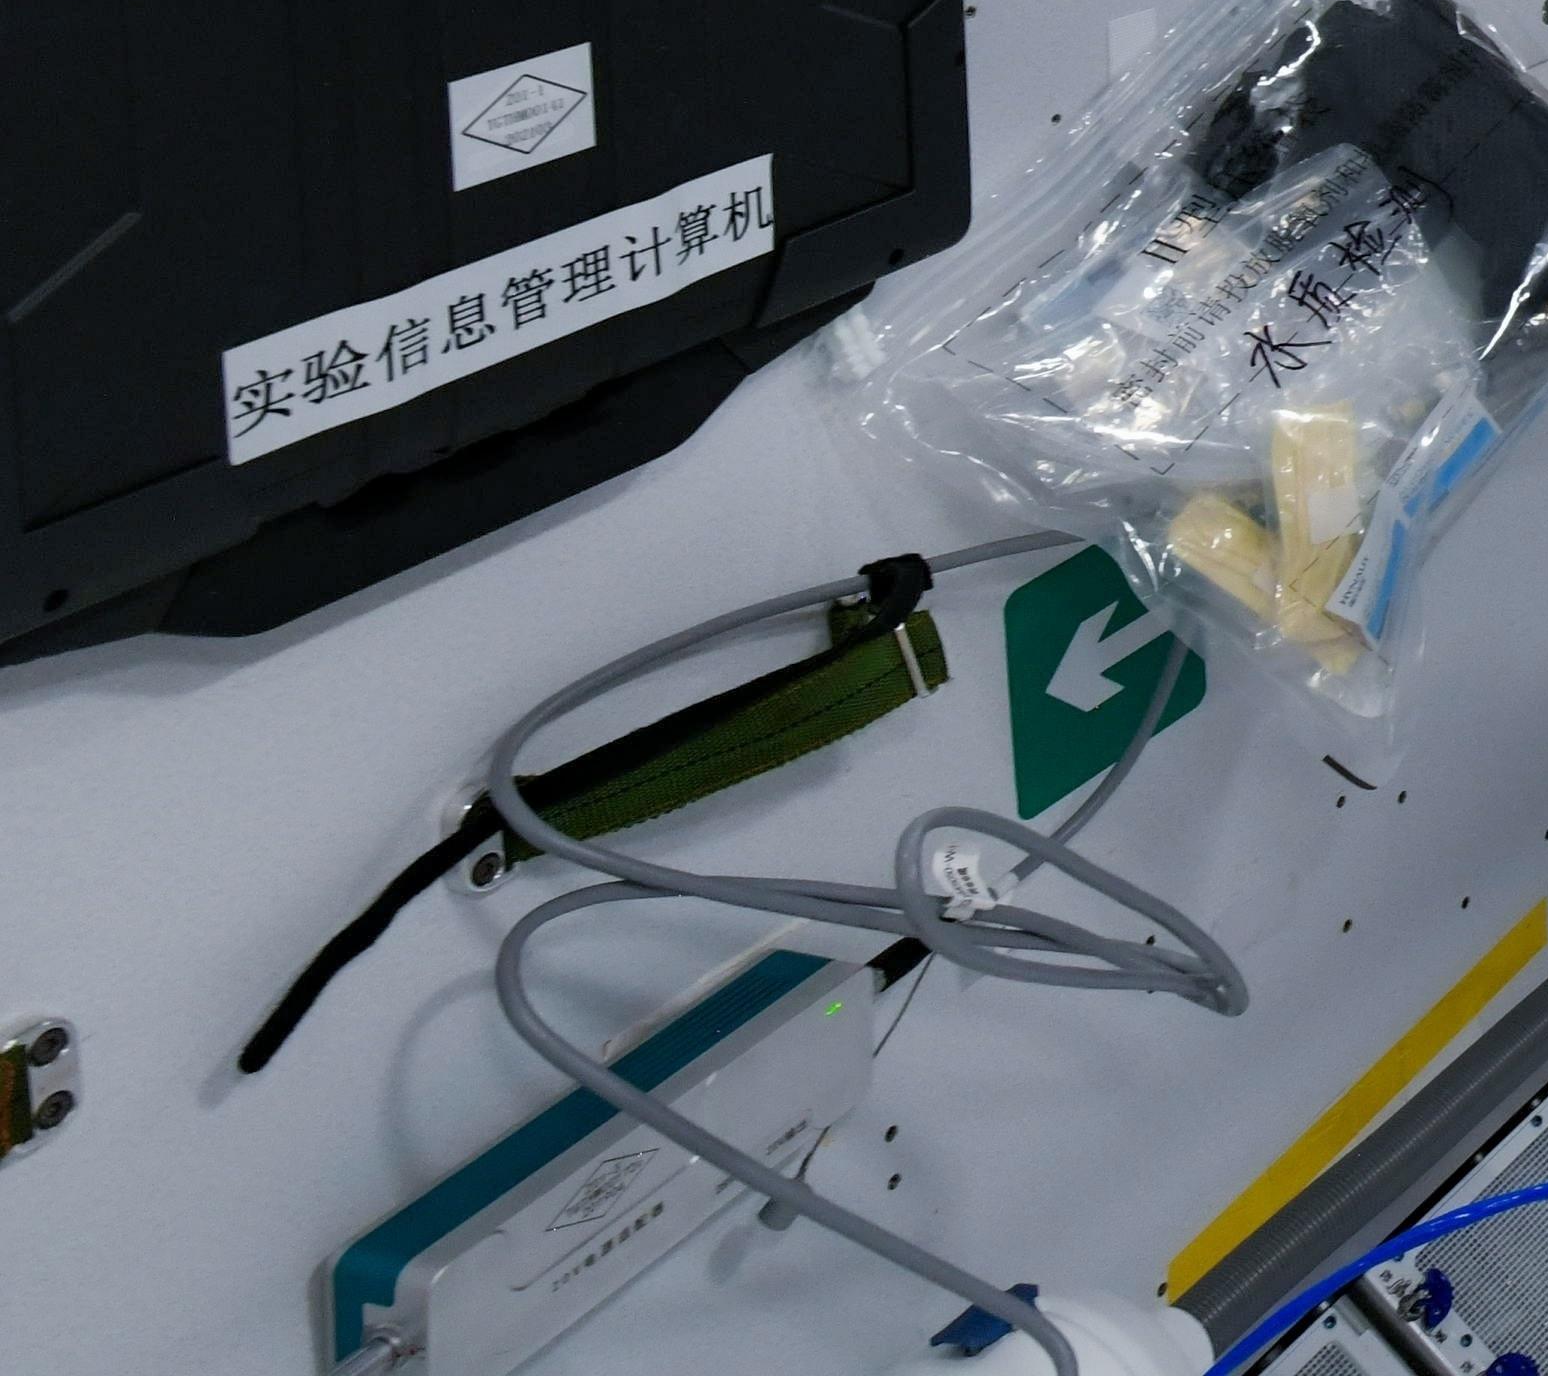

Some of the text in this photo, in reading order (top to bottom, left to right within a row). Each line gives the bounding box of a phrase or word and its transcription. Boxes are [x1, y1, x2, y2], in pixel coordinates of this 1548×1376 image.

[231, 183, 774, 437] 实验信息管理计算机
